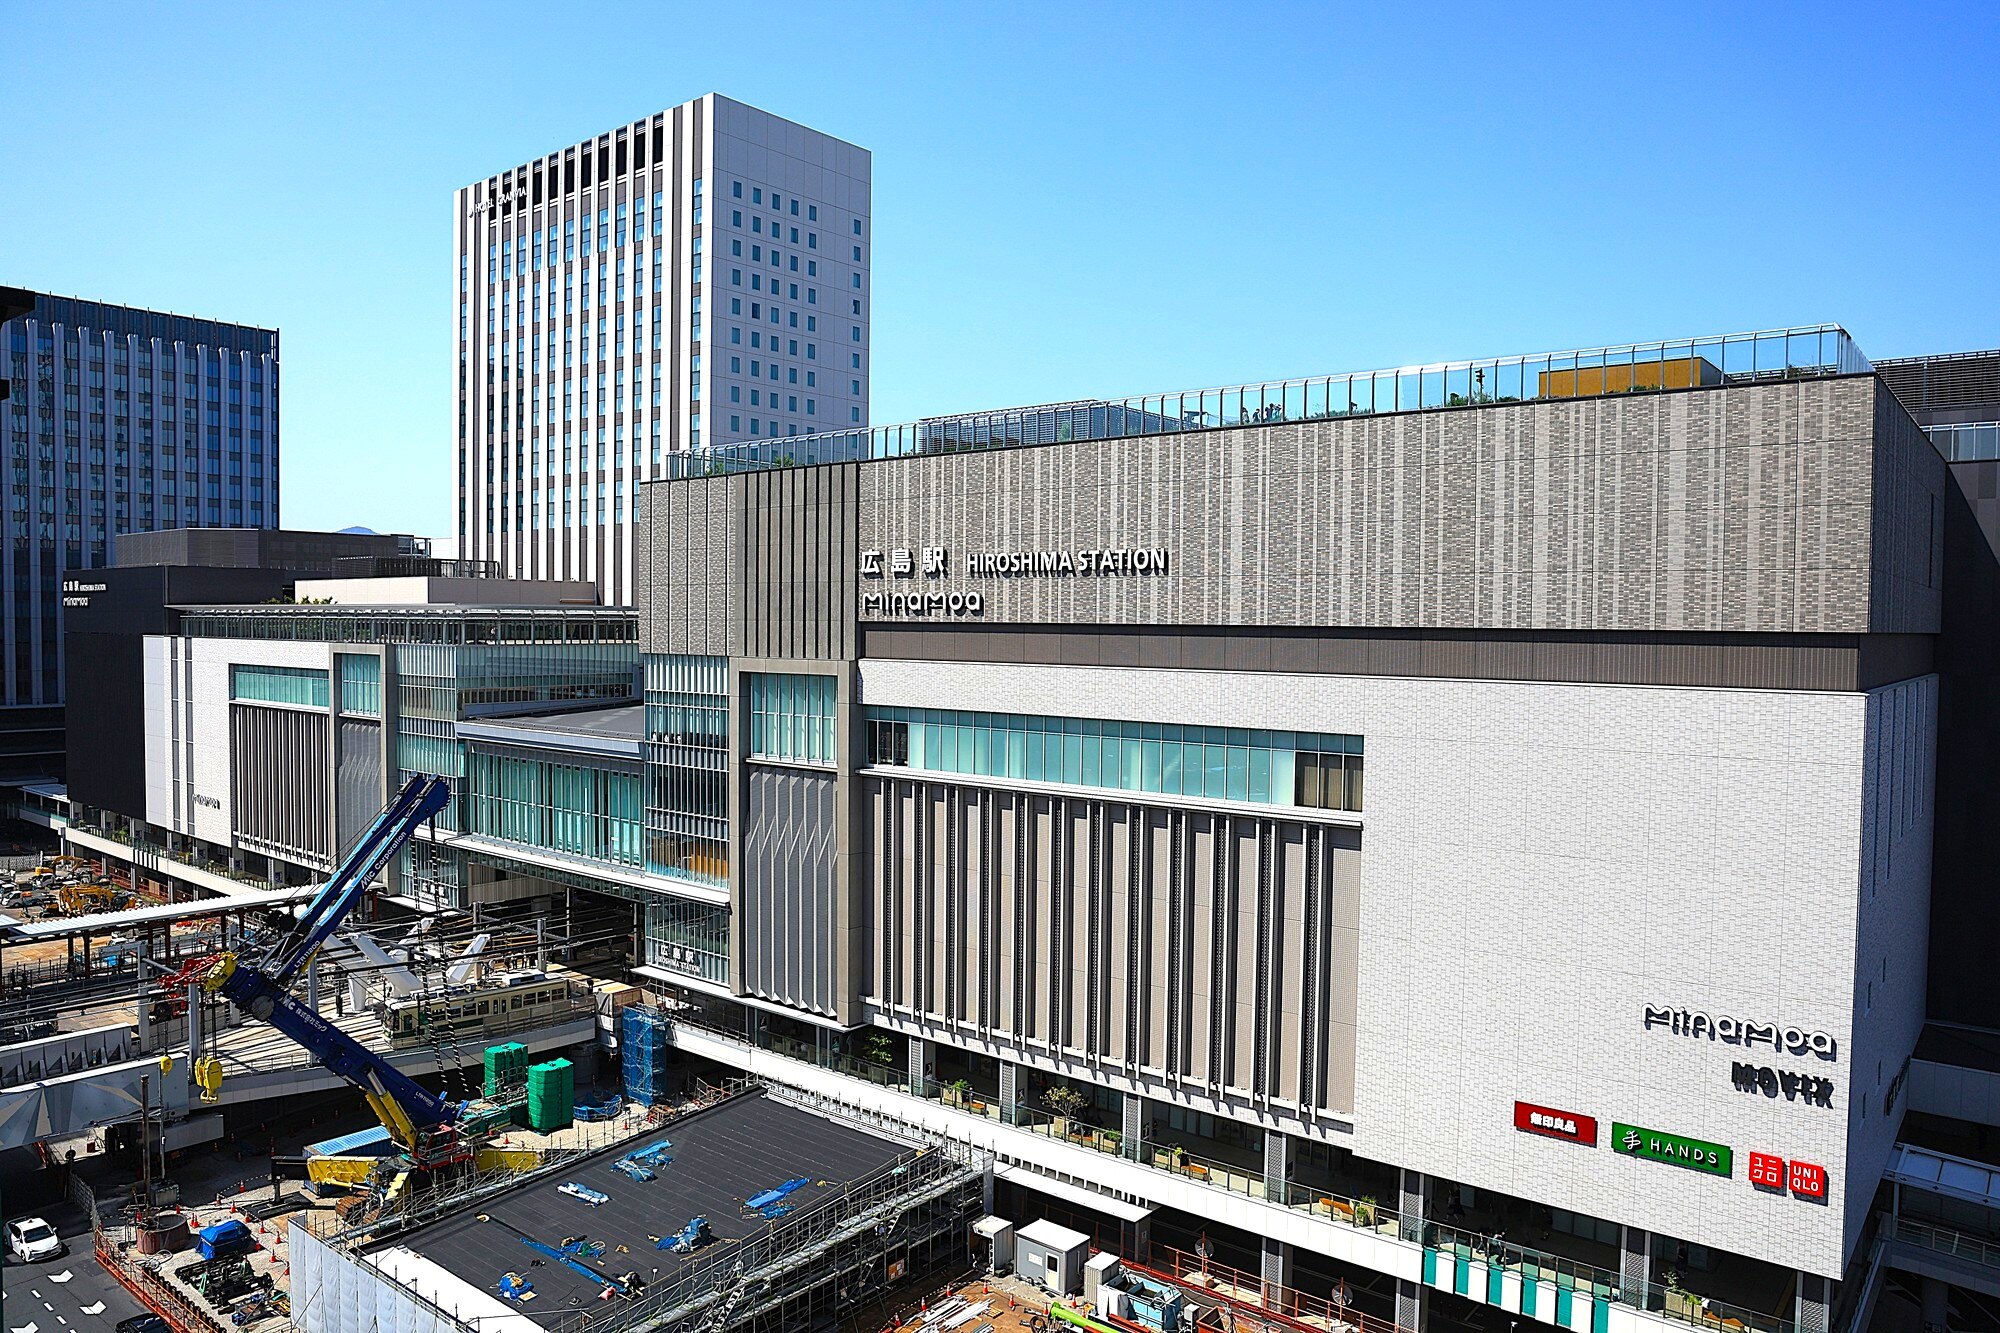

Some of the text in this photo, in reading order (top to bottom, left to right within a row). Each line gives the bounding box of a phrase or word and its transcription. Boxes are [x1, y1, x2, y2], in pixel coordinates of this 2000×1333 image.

[861, 547, 945, 574] 広島駅
[966, 547, 1165, 573] HIROSHIMA STATION
[375, 831, 407, 870] Corporation
[294, 940, 321, 968] LTR11200
[1731, 1061, 1835, 1108] MOVIX
[1650, 1138, 1717, 1164] HANDS
[1753, 1156, 1778, 1171] ユニ
[1792, 1177, 1819, 1192] QLO
[1793, 1165, 1817, 1180] UNI
